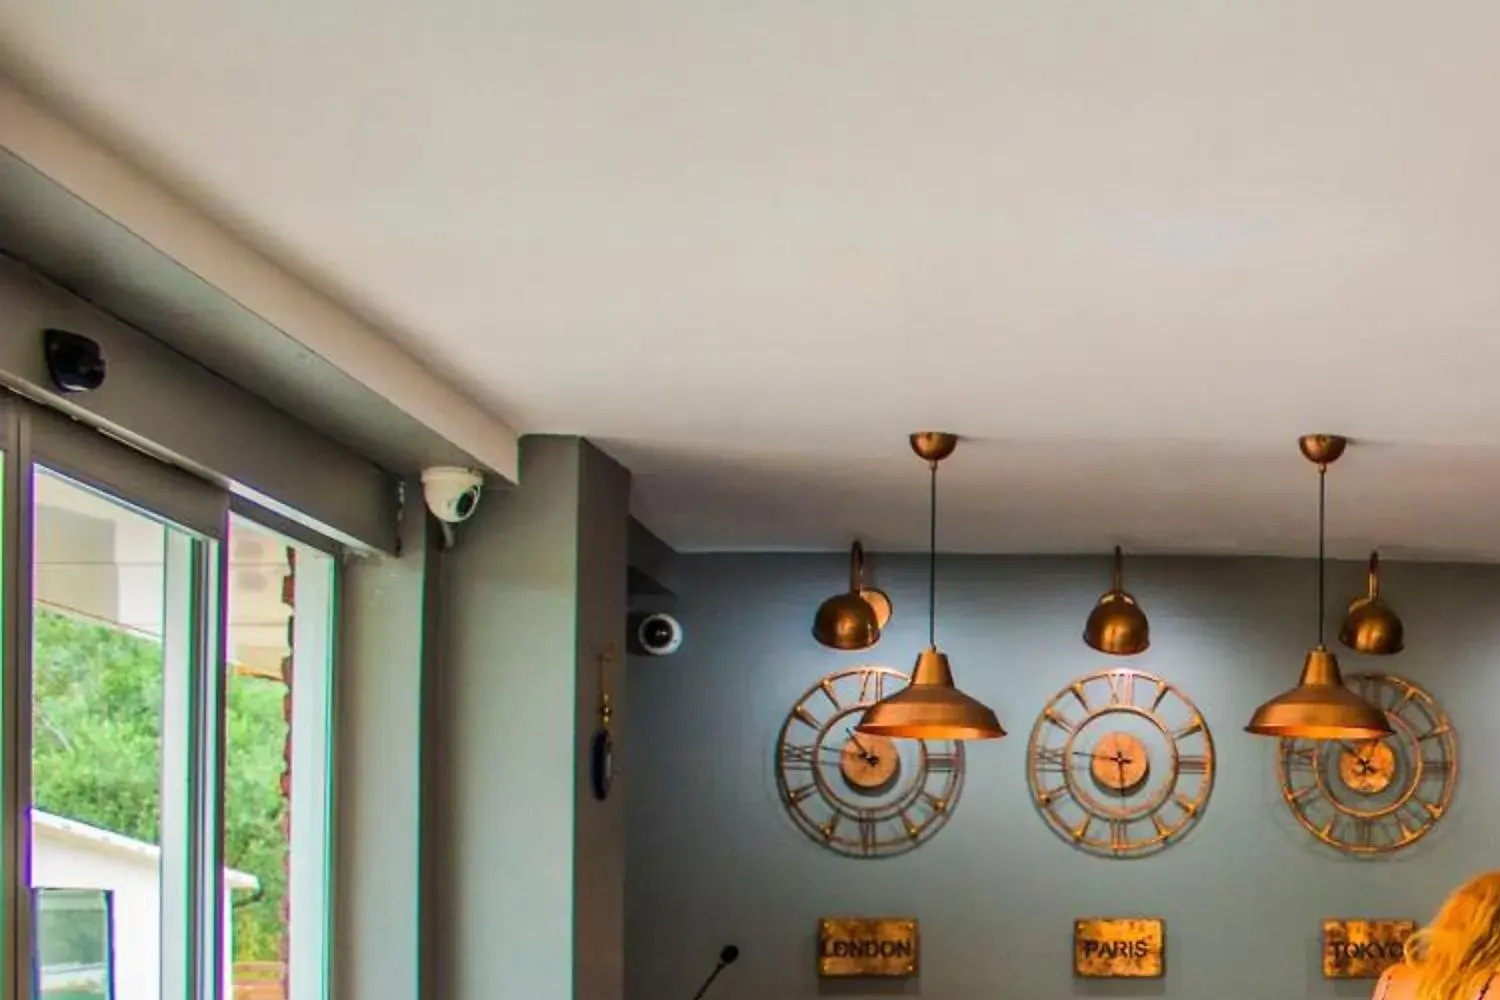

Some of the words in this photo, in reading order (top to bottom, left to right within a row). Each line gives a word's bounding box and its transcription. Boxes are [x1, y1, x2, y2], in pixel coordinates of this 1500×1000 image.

[821, 940, 912, 958] LONDON
[1083, 940, 1147, 958] PARIS
[1330, 941, 1404, 959] TOKYO
